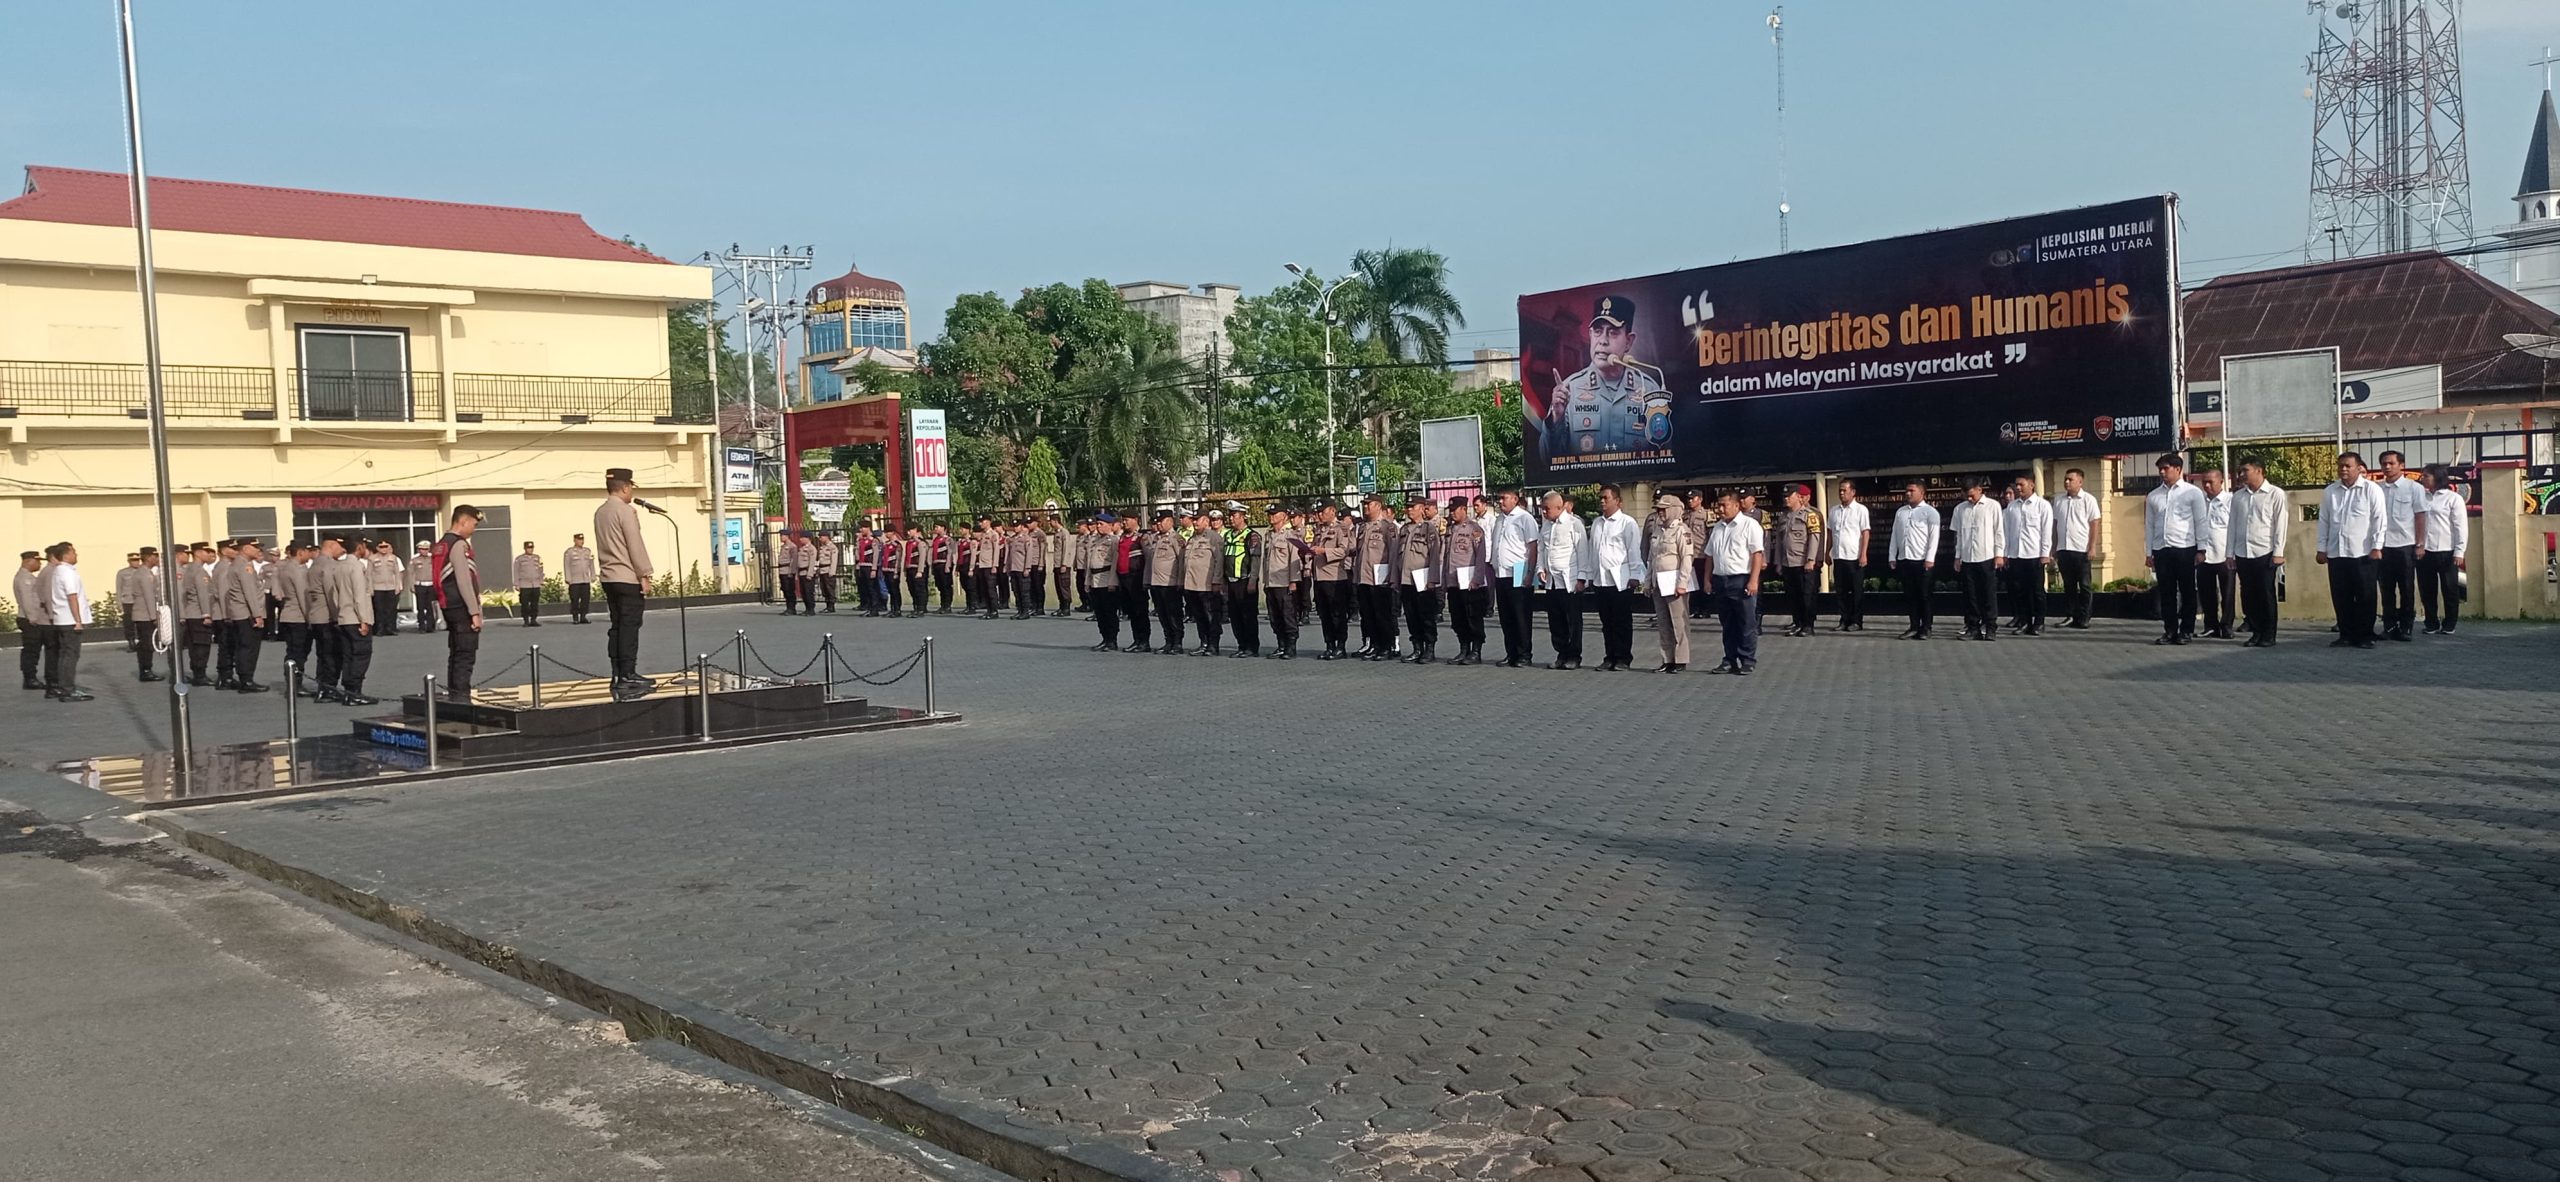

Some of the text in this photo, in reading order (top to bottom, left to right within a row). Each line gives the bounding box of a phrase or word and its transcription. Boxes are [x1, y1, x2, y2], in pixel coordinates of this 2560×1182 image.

[2041, 220, 2153, 249] KEPOLISIAN DAERAH
[2042, 237, 2153, 262] SUMATERA UTARA
[1699, 278, 2130, 368] Berintegritas dan Humanis
[1700, 350, 1993, 396] dalam Melayani Masyarakat
[1574, 405, 1600, 413] WHISNU
[2114, 415, 2159, 431] SPRIPIM
[2019, 428, 2083, 442] PRESISI
[2115, 430, 2136, 438] POLDA
[2137, 429, 2160, 437] SUMUT
[916, 442, 946, 475] 110
[731, 472, 750, 480] ATM
